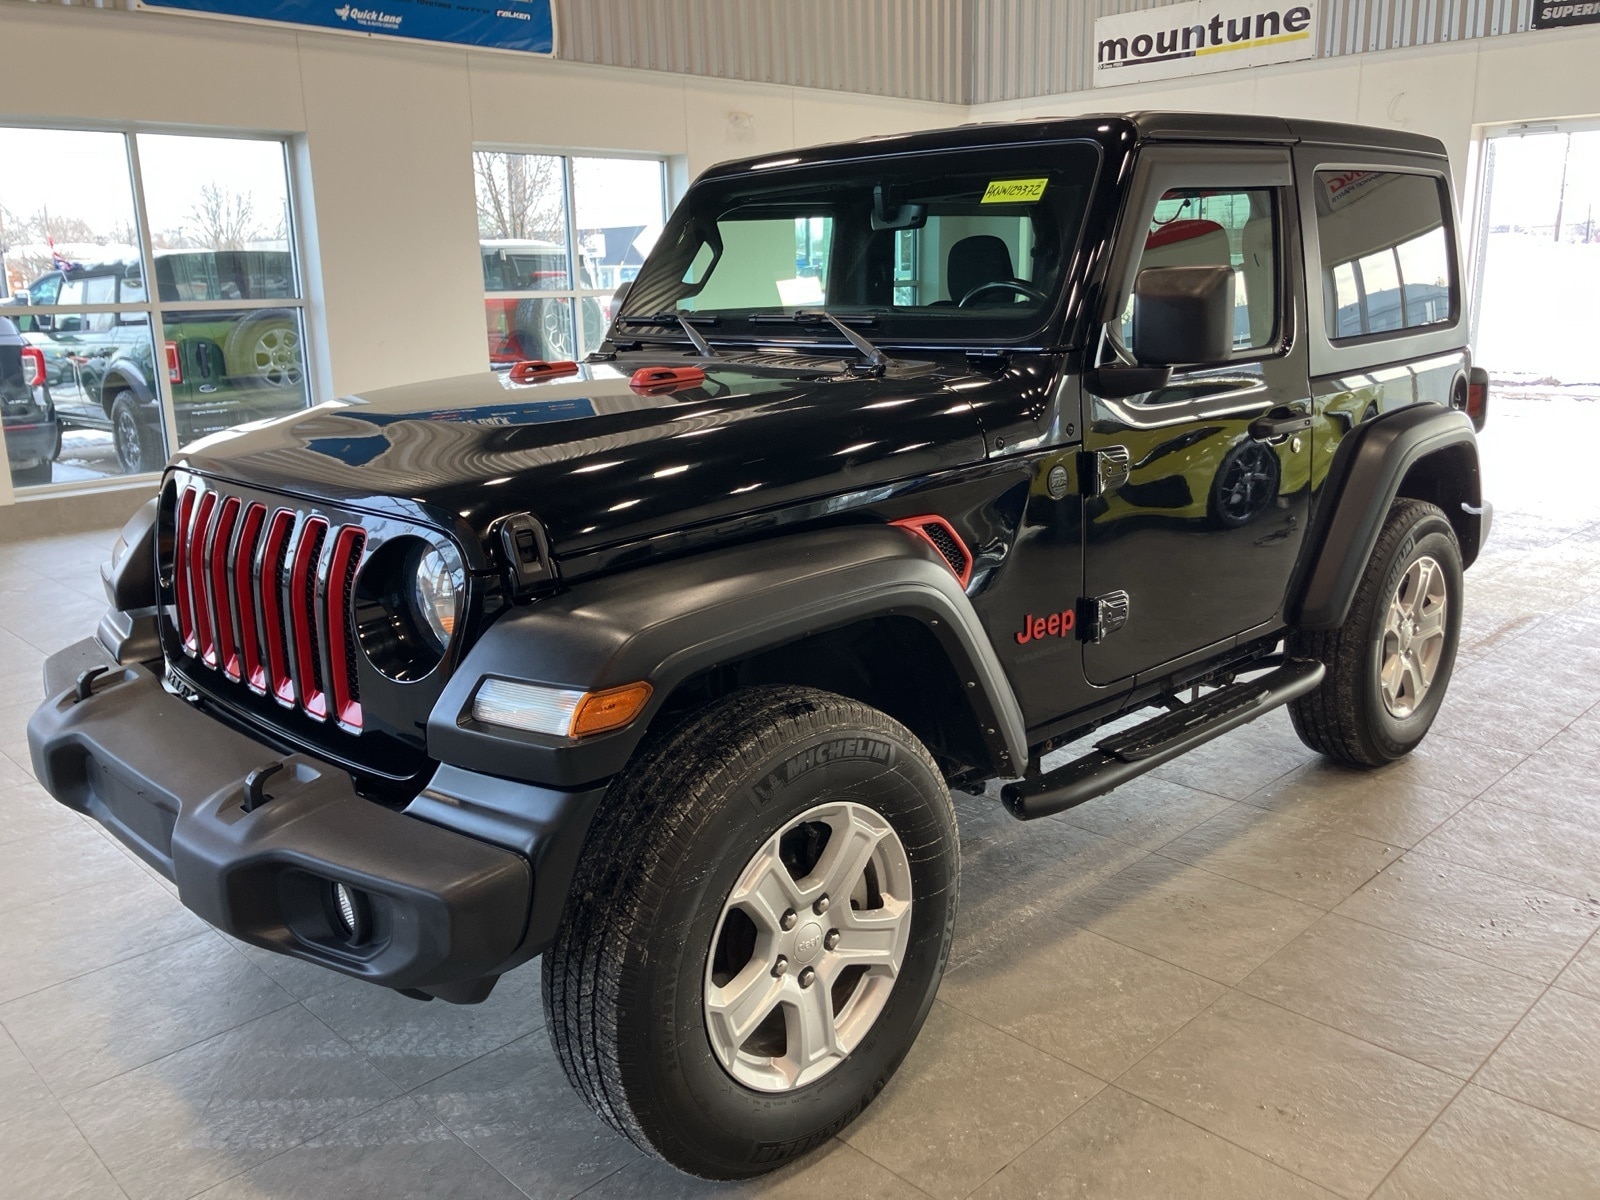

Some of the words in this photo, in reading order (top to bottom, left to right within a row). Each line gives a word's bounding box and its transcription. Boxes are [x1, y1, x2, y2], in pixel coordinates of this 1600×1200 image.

[350, 8, 378, 21] Quick
[378, 11, 402, 24] Lane
[496, 9, 531, 21] FALKEN
[1541, 2, 1600, 20] SUPERI
[1097, 6, 1311, 63] mountune
[1014, 608, 1075, 645] Jeep
[786, 739, 890, 781] MICHELIN
